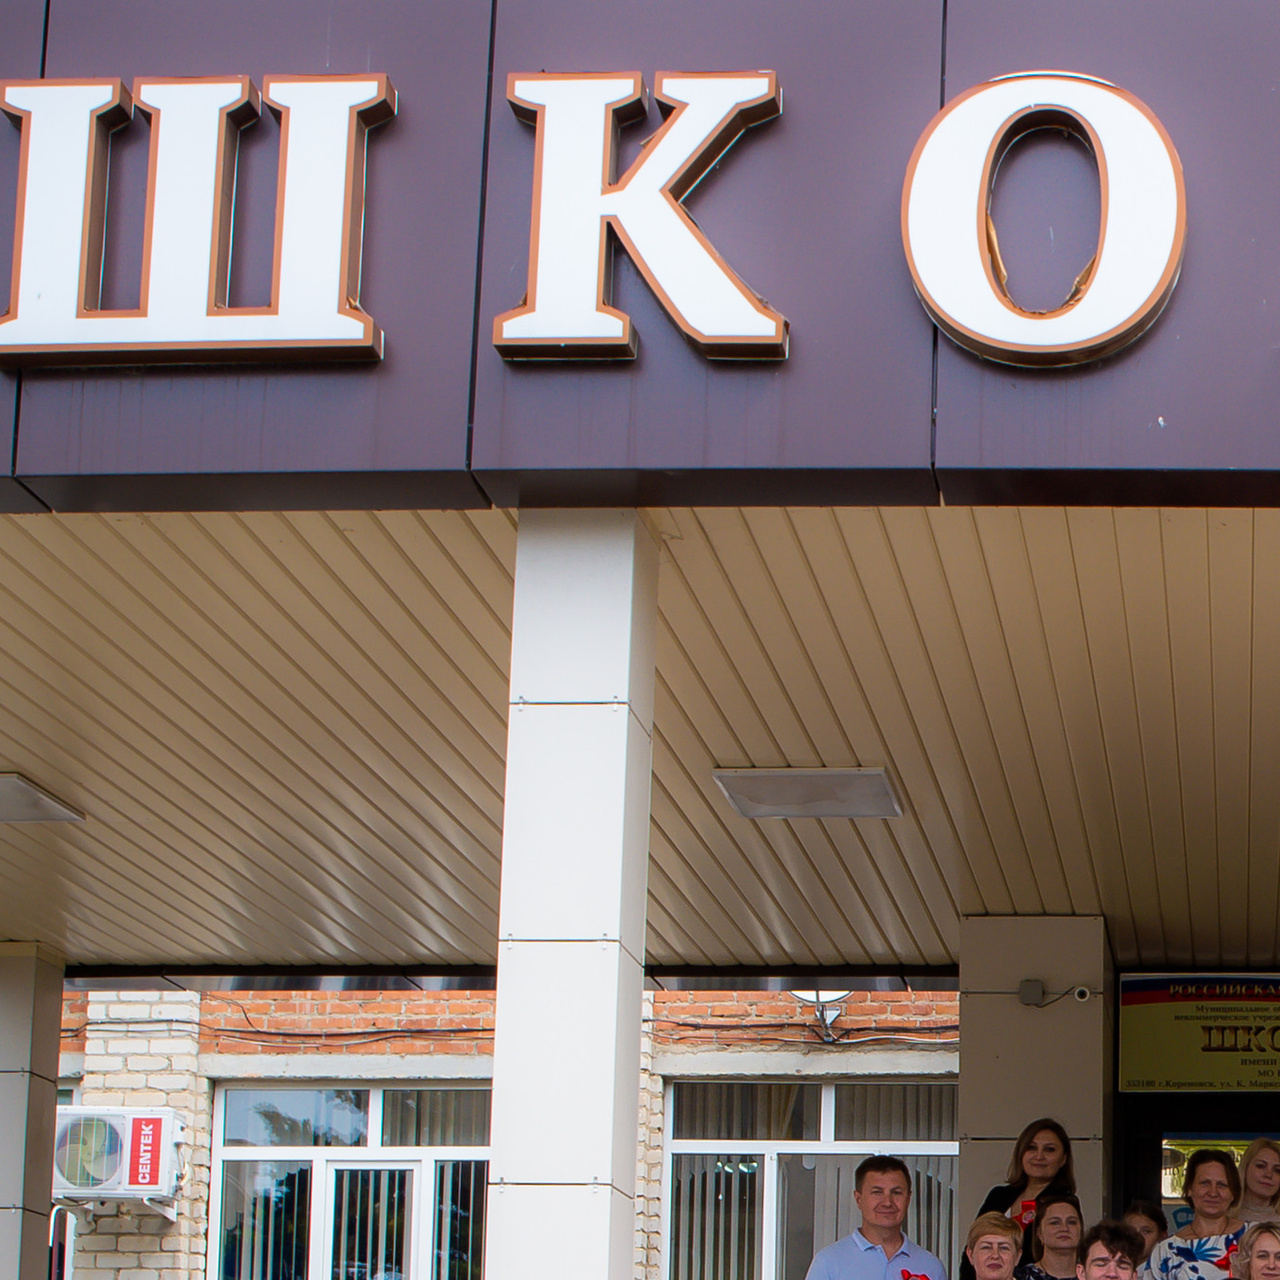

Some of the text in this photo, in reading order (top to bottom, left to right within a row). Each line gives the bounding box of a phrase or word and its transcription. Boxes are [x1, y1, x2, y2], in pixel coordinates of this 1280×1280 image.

[1195, 1005, 1270, 1014] Муниципальное
[1240, 1058, 1277, 1066] имени
[1258, 1070, 1274, 1078] МО
[138, 1123, 153, 1184] CENTEK
